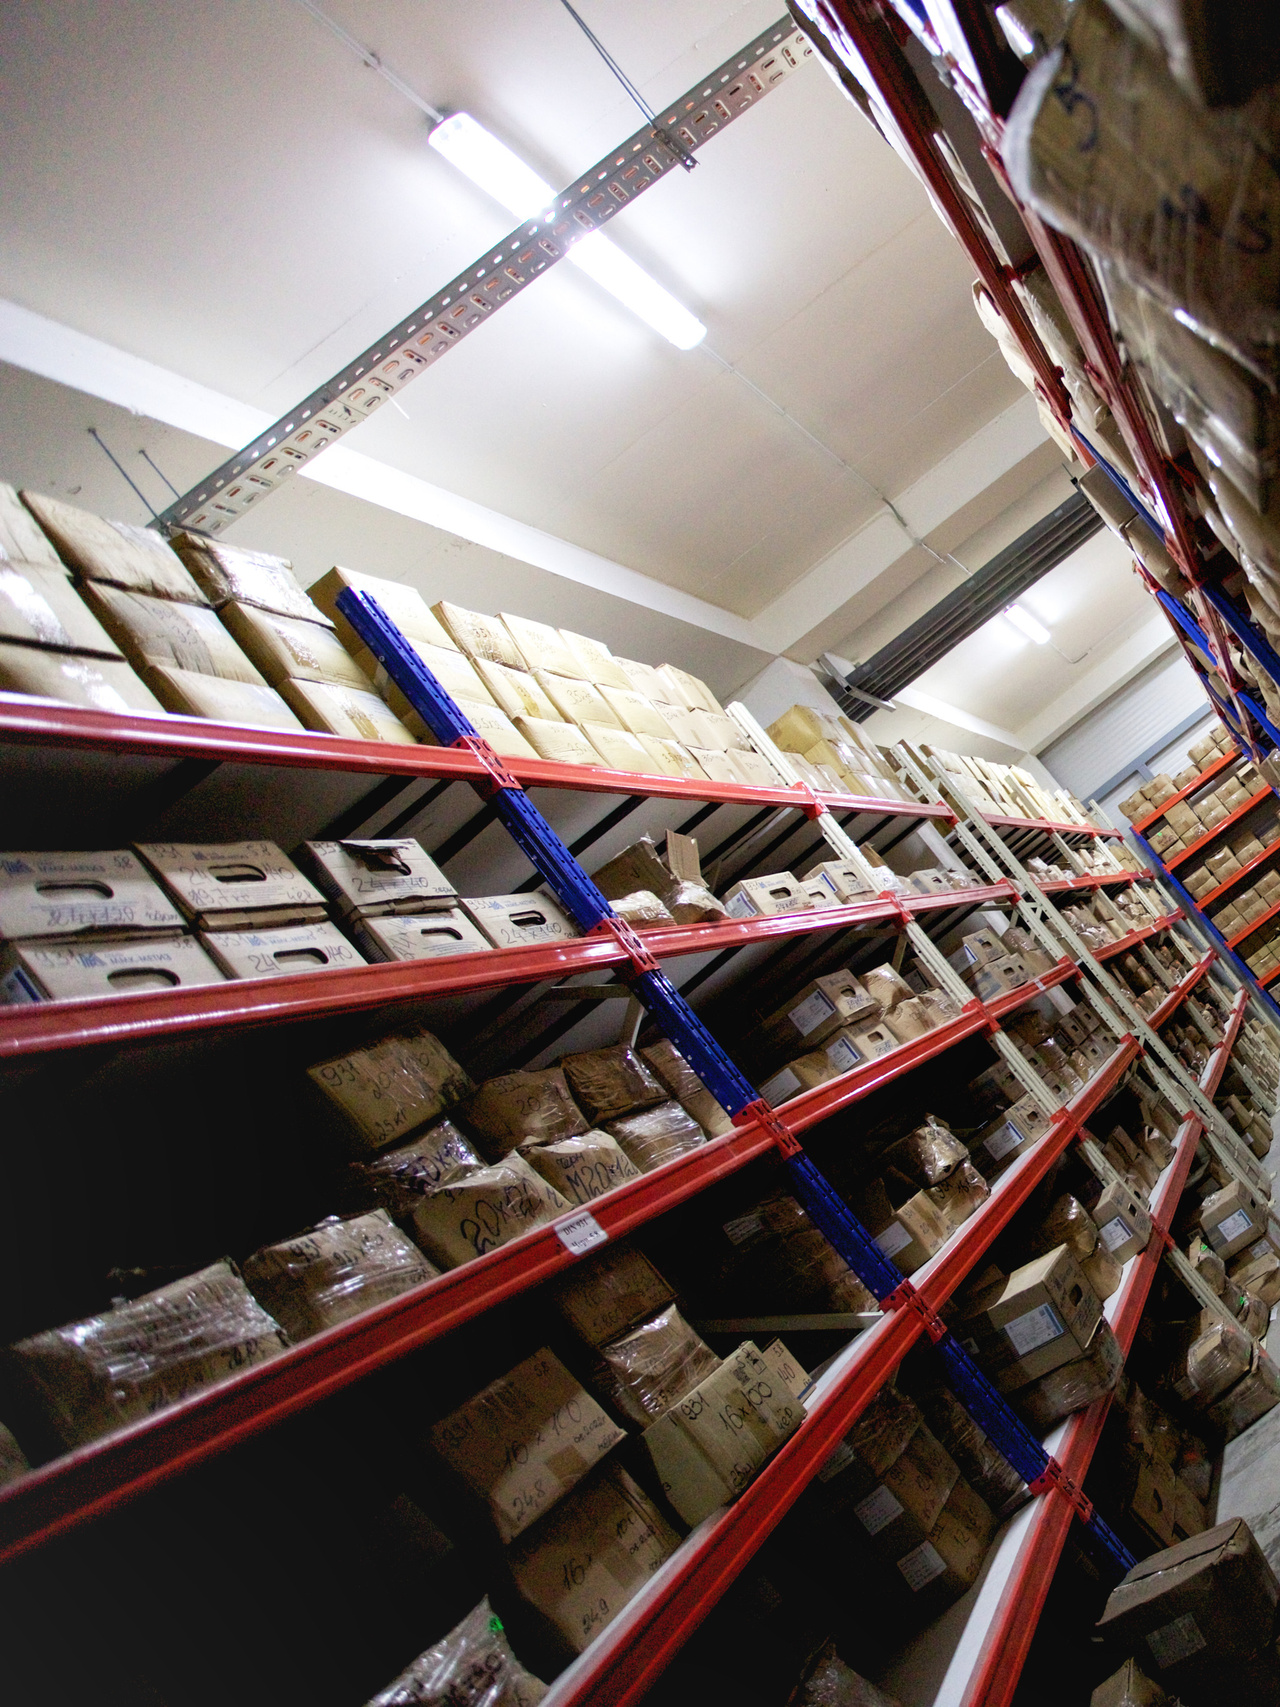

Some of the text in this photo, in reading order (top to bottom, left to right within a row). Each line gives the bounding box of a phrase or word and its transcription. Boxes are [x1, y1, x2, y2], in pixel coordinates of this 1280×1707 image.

[247, 953, 284, 974] 24
[562, 1223, 577, 1236] DIN
[680, 1390, 710, 1421] 931
[718, 1381, 773, 1437] 16x100
